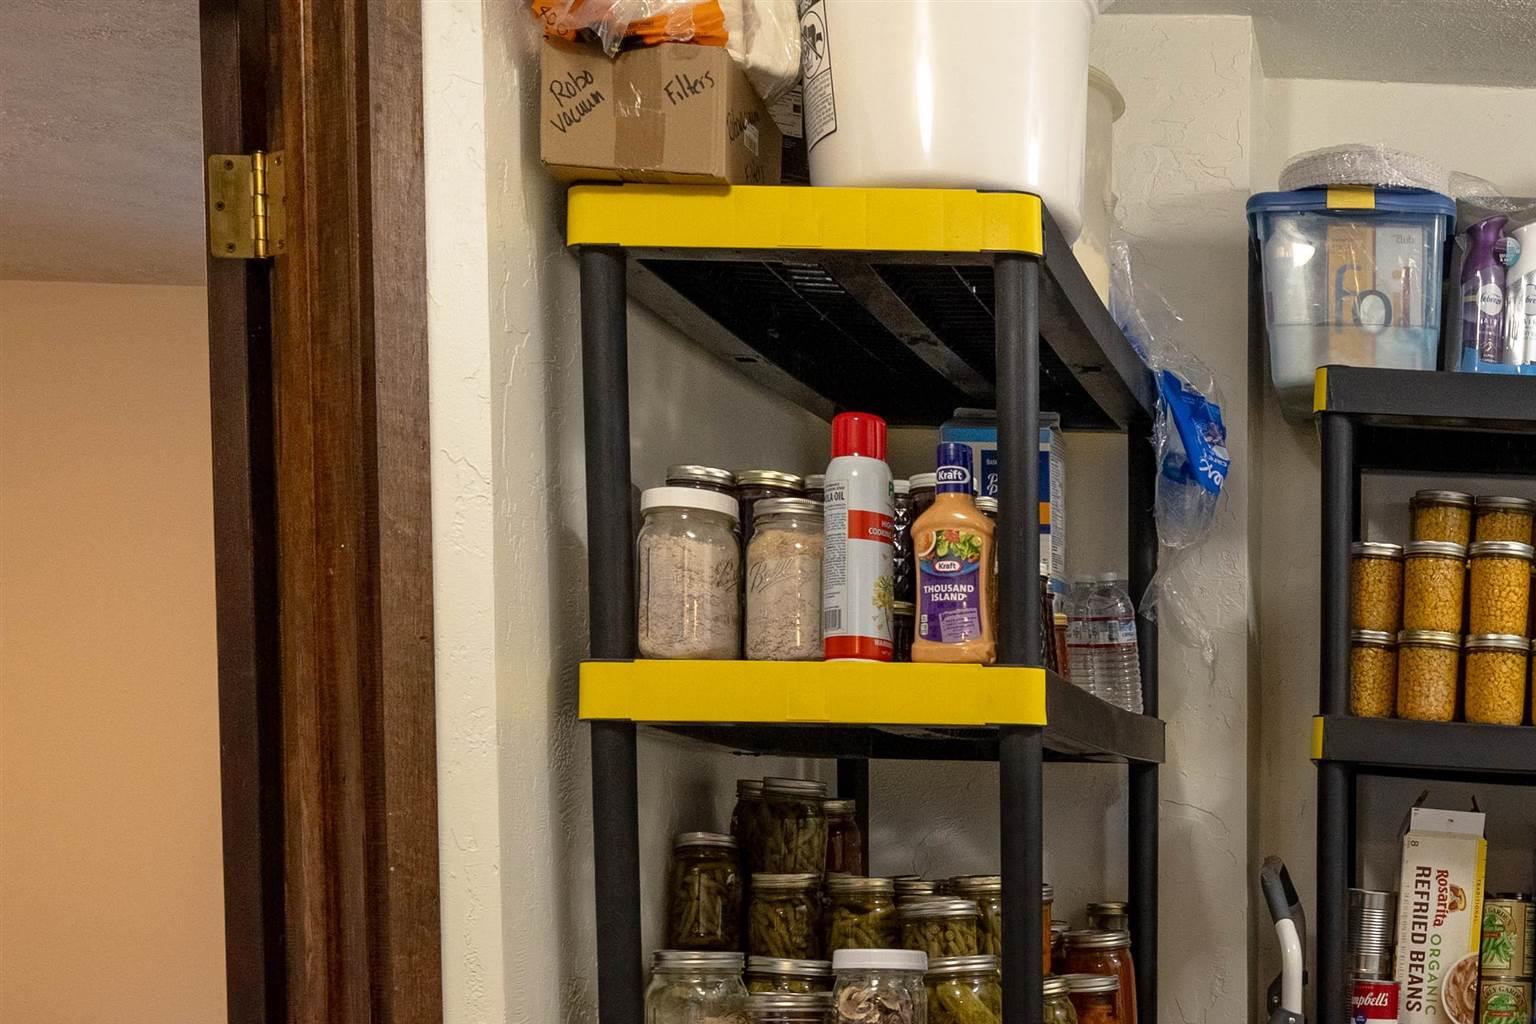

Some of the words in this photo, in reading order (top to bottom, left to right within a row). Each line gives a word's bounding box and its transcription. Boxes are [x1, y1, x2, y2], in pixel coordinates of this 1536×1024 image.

[550, 69, 594, 107] Robo
[664, 71, 716, 105] Filters
[938, 469, 963, 481] Kraft
[938, 561, 957, 571] Kraft
[923, 583, 975, 593] THOUSAND
[931, 593, 968, 602] ISLAND
[1411, 866, 1432, 945] REFRIED
[1433, 869, 1449, 927] Rosarita
[1405, 950, 1426, 1012] BEANS
[1425, 933, 1442, 1016] ORGANIC
